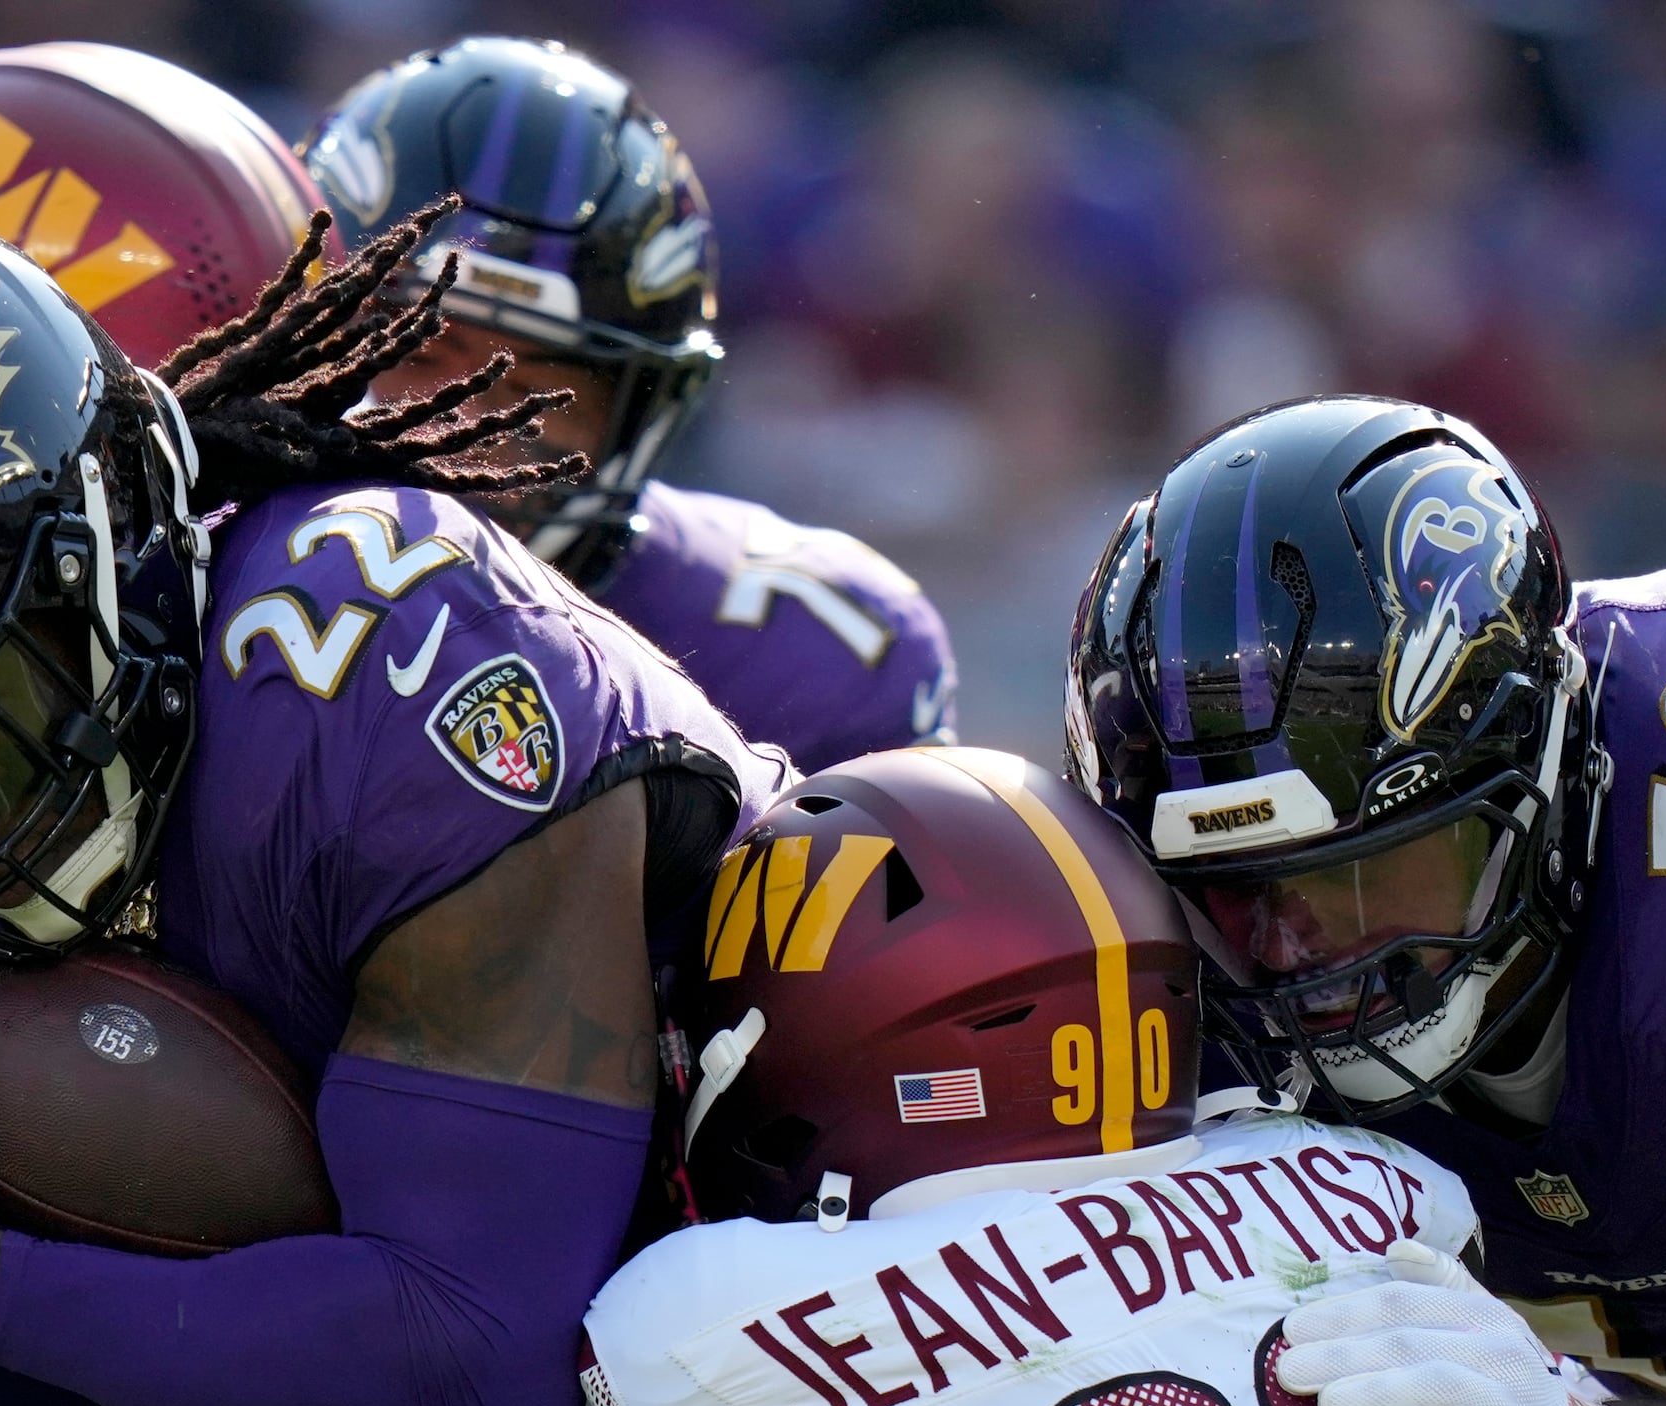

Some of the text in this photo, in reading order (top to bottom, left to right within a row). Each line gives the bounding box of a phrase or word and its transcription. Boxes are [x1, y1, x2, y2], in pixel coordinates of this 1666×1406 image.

[220, 506, 473, 701] 22
[440, 665, 519, 731] RAVENS
[1368, 769, 1441, 817] OAKLEY
[1188, 798, 1276, 834] RAVENS
[94, 1024, 135, 1060] 155
[144, 1042, 158, 1056] 24
[1051, 1008, 1170, 1126] 90
[1534, 1193, 1580, 1217] NFL
